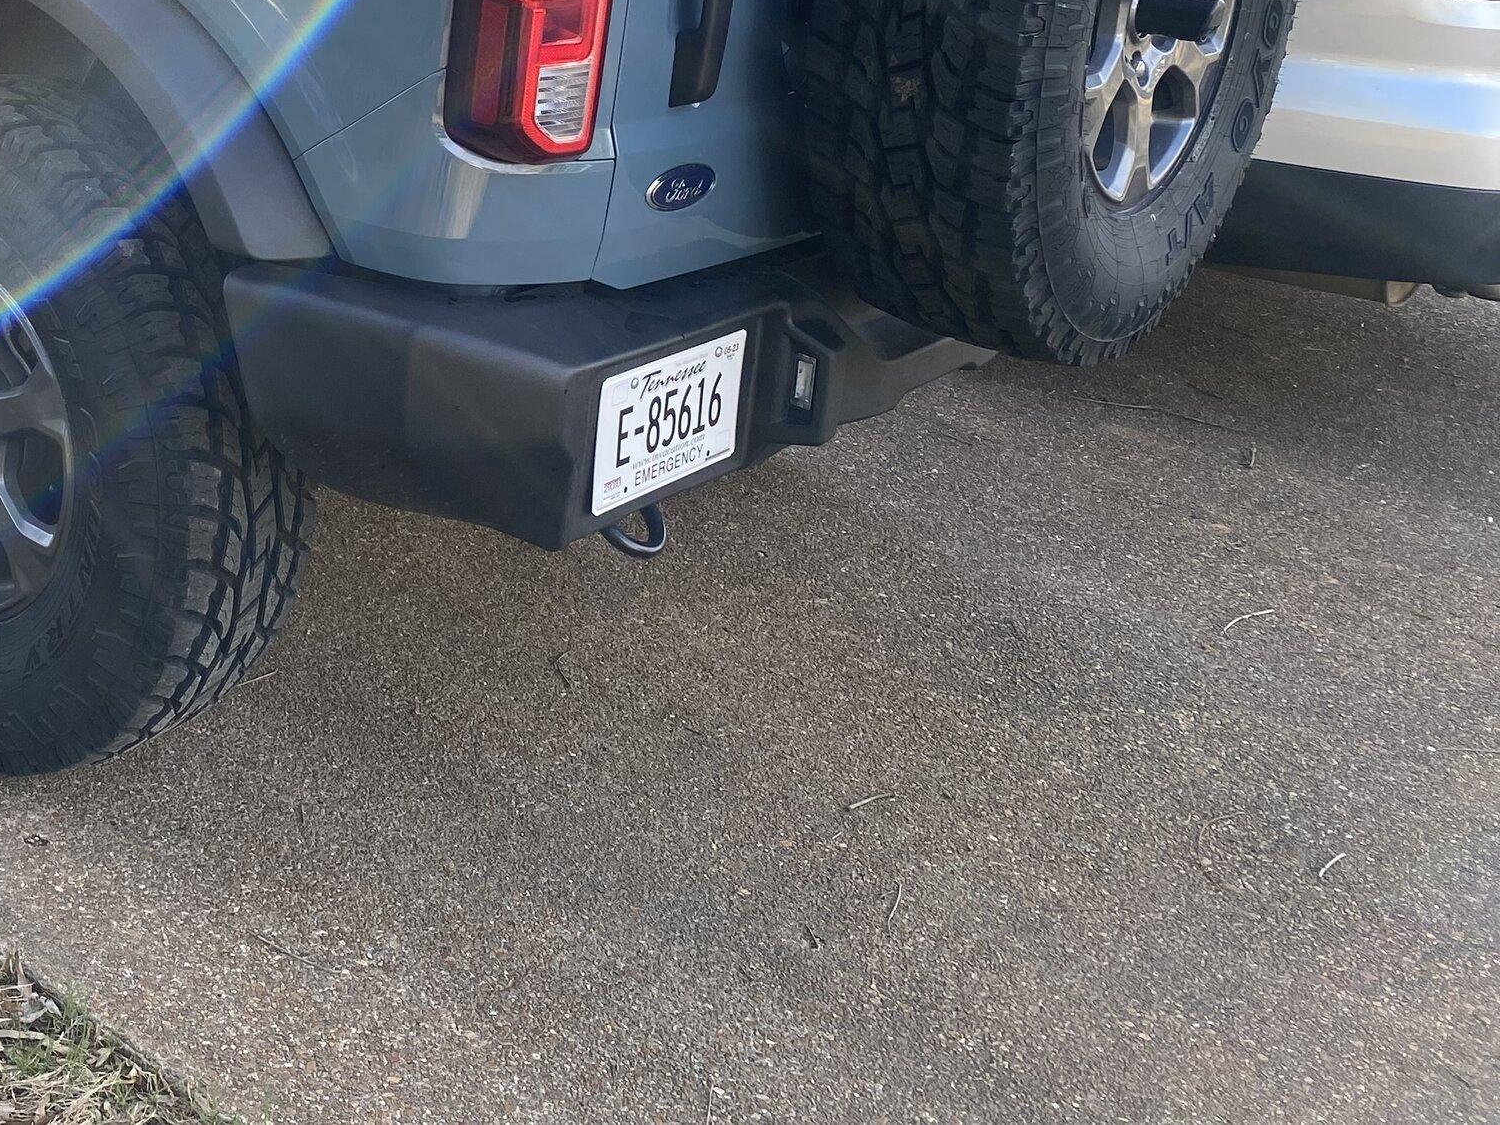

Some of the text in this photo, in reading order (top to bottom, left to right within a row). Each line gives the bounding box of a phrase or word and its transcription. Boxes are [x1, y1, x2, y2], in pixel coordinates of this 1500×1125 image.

[665, 178, 705, 203] Ford
[640, 360, 707, 399] Tennessee
[615, 371, 723, 469] E-85616
[634, 443, 704, 487] EMERGENCY
